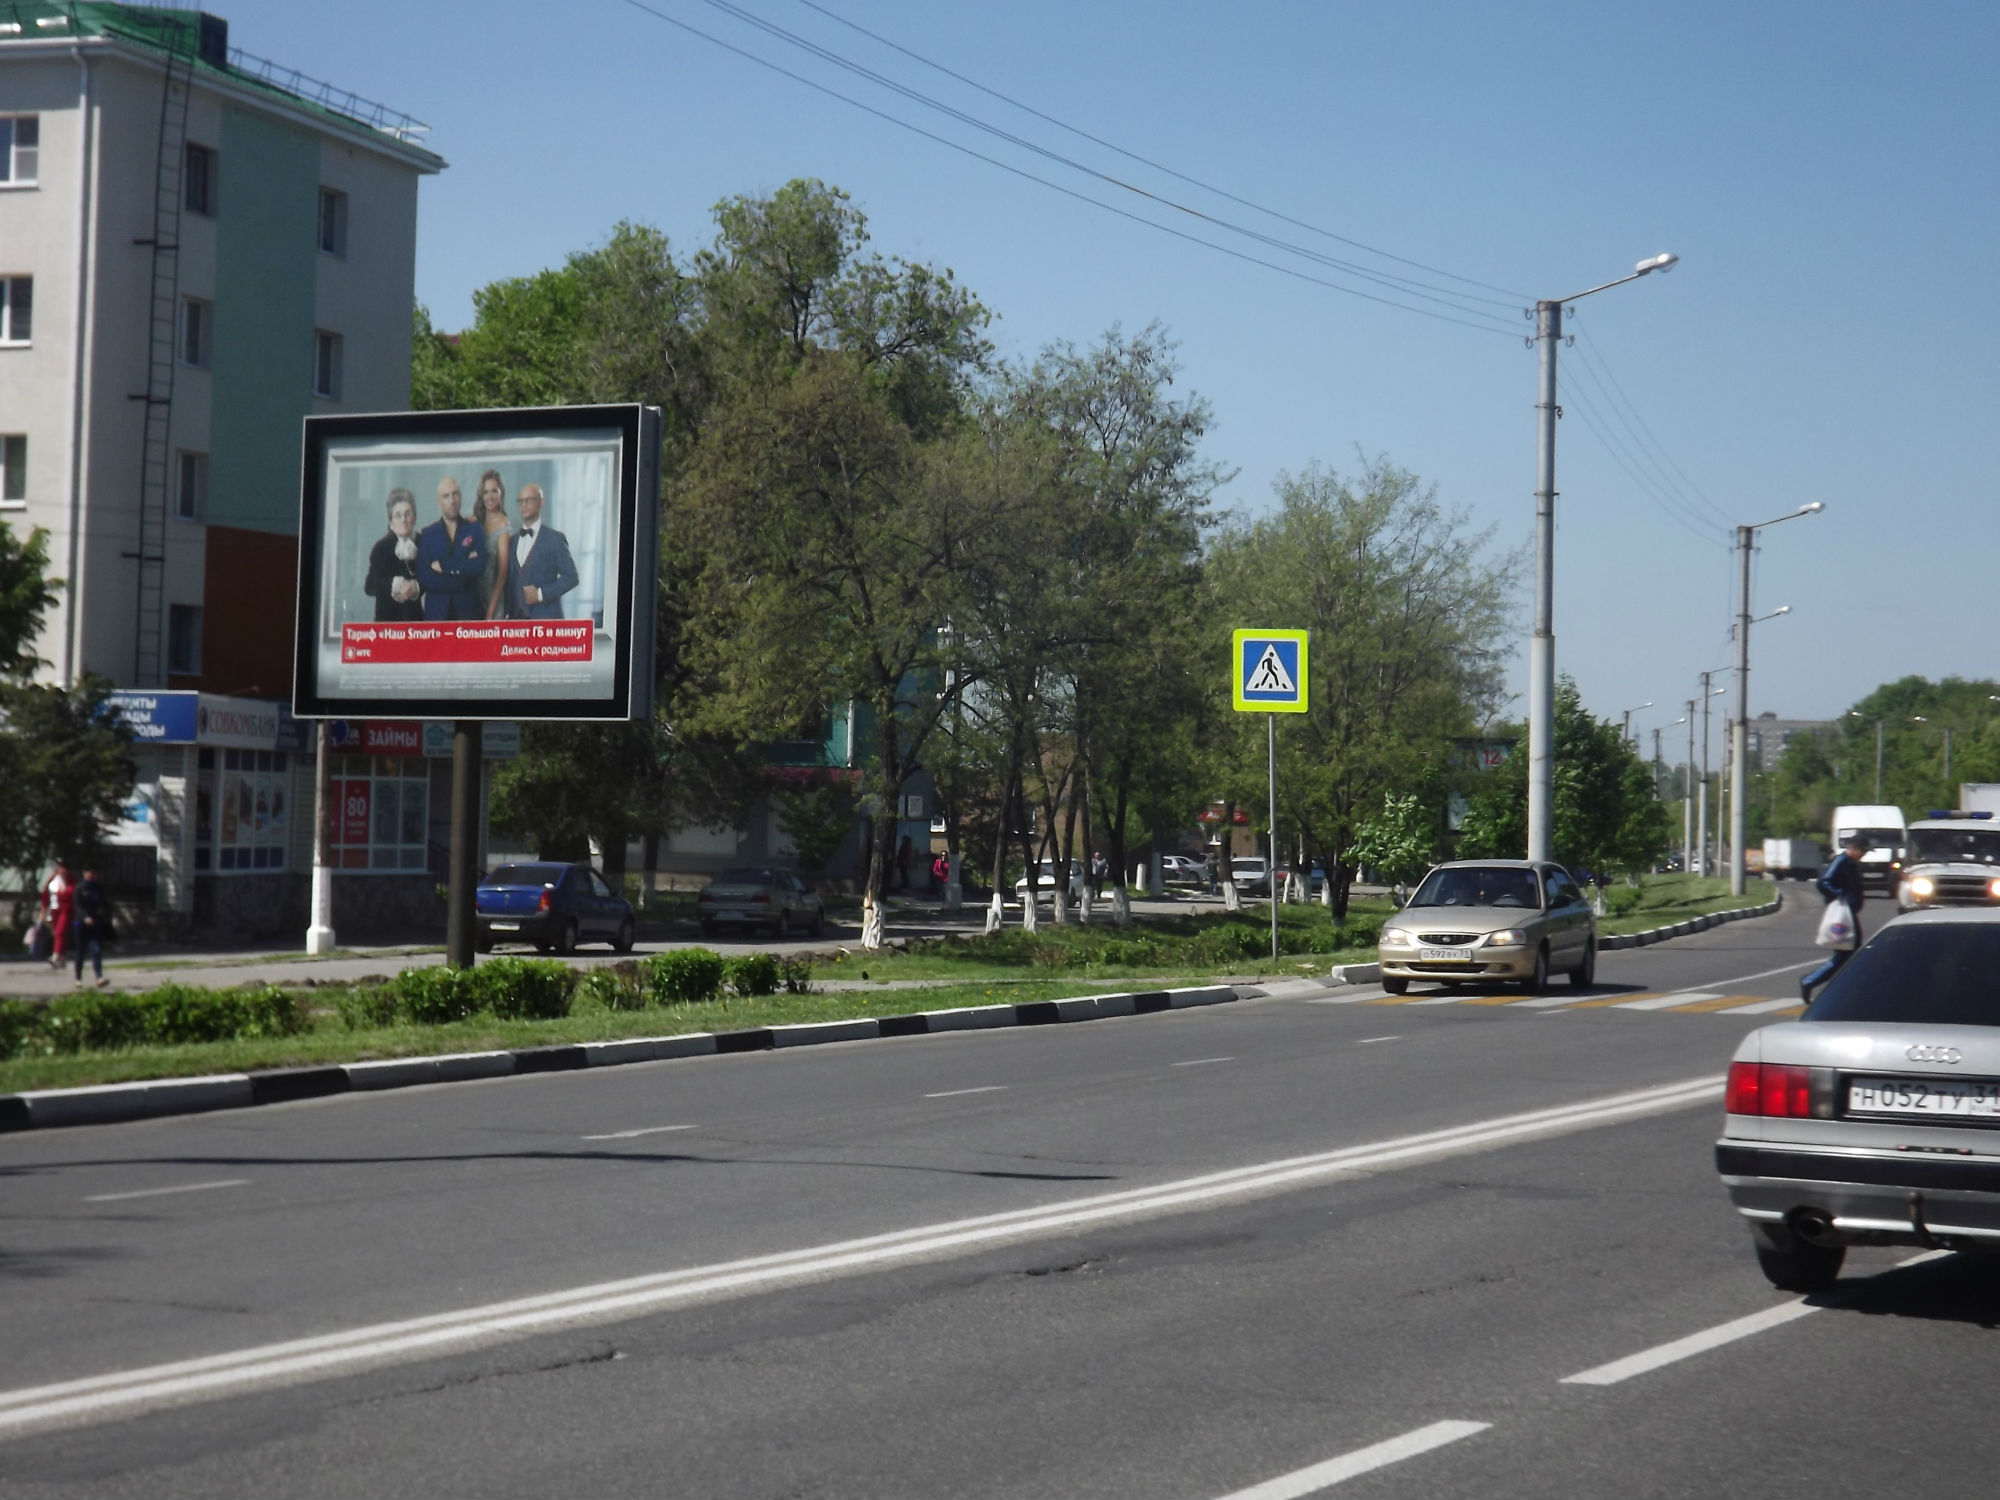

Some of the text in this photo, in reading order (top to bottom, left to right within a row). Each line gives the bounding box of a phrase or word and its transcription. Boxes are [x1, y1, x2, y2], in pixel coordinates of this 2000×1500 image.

[346, 627, 377, 642] Тариф
[379, 627, 406, 639] «Наш
[408, 626, 441, 639] Smart»
[456, 625, 500, 639] большой
[502, 627, 530, 638] пакет
[532, 625, 545, 638] ГБ
[546, 627, 553, 637] и
[555, 626, 587, 639] минут
[501, 643, 586, 656] Делись с родными!
[208, 708, 277, 738] СОВКОМБАНК
[367, 727, 418, 748] ЗАЙМЫ
[347, 796, 367, 817] 80
